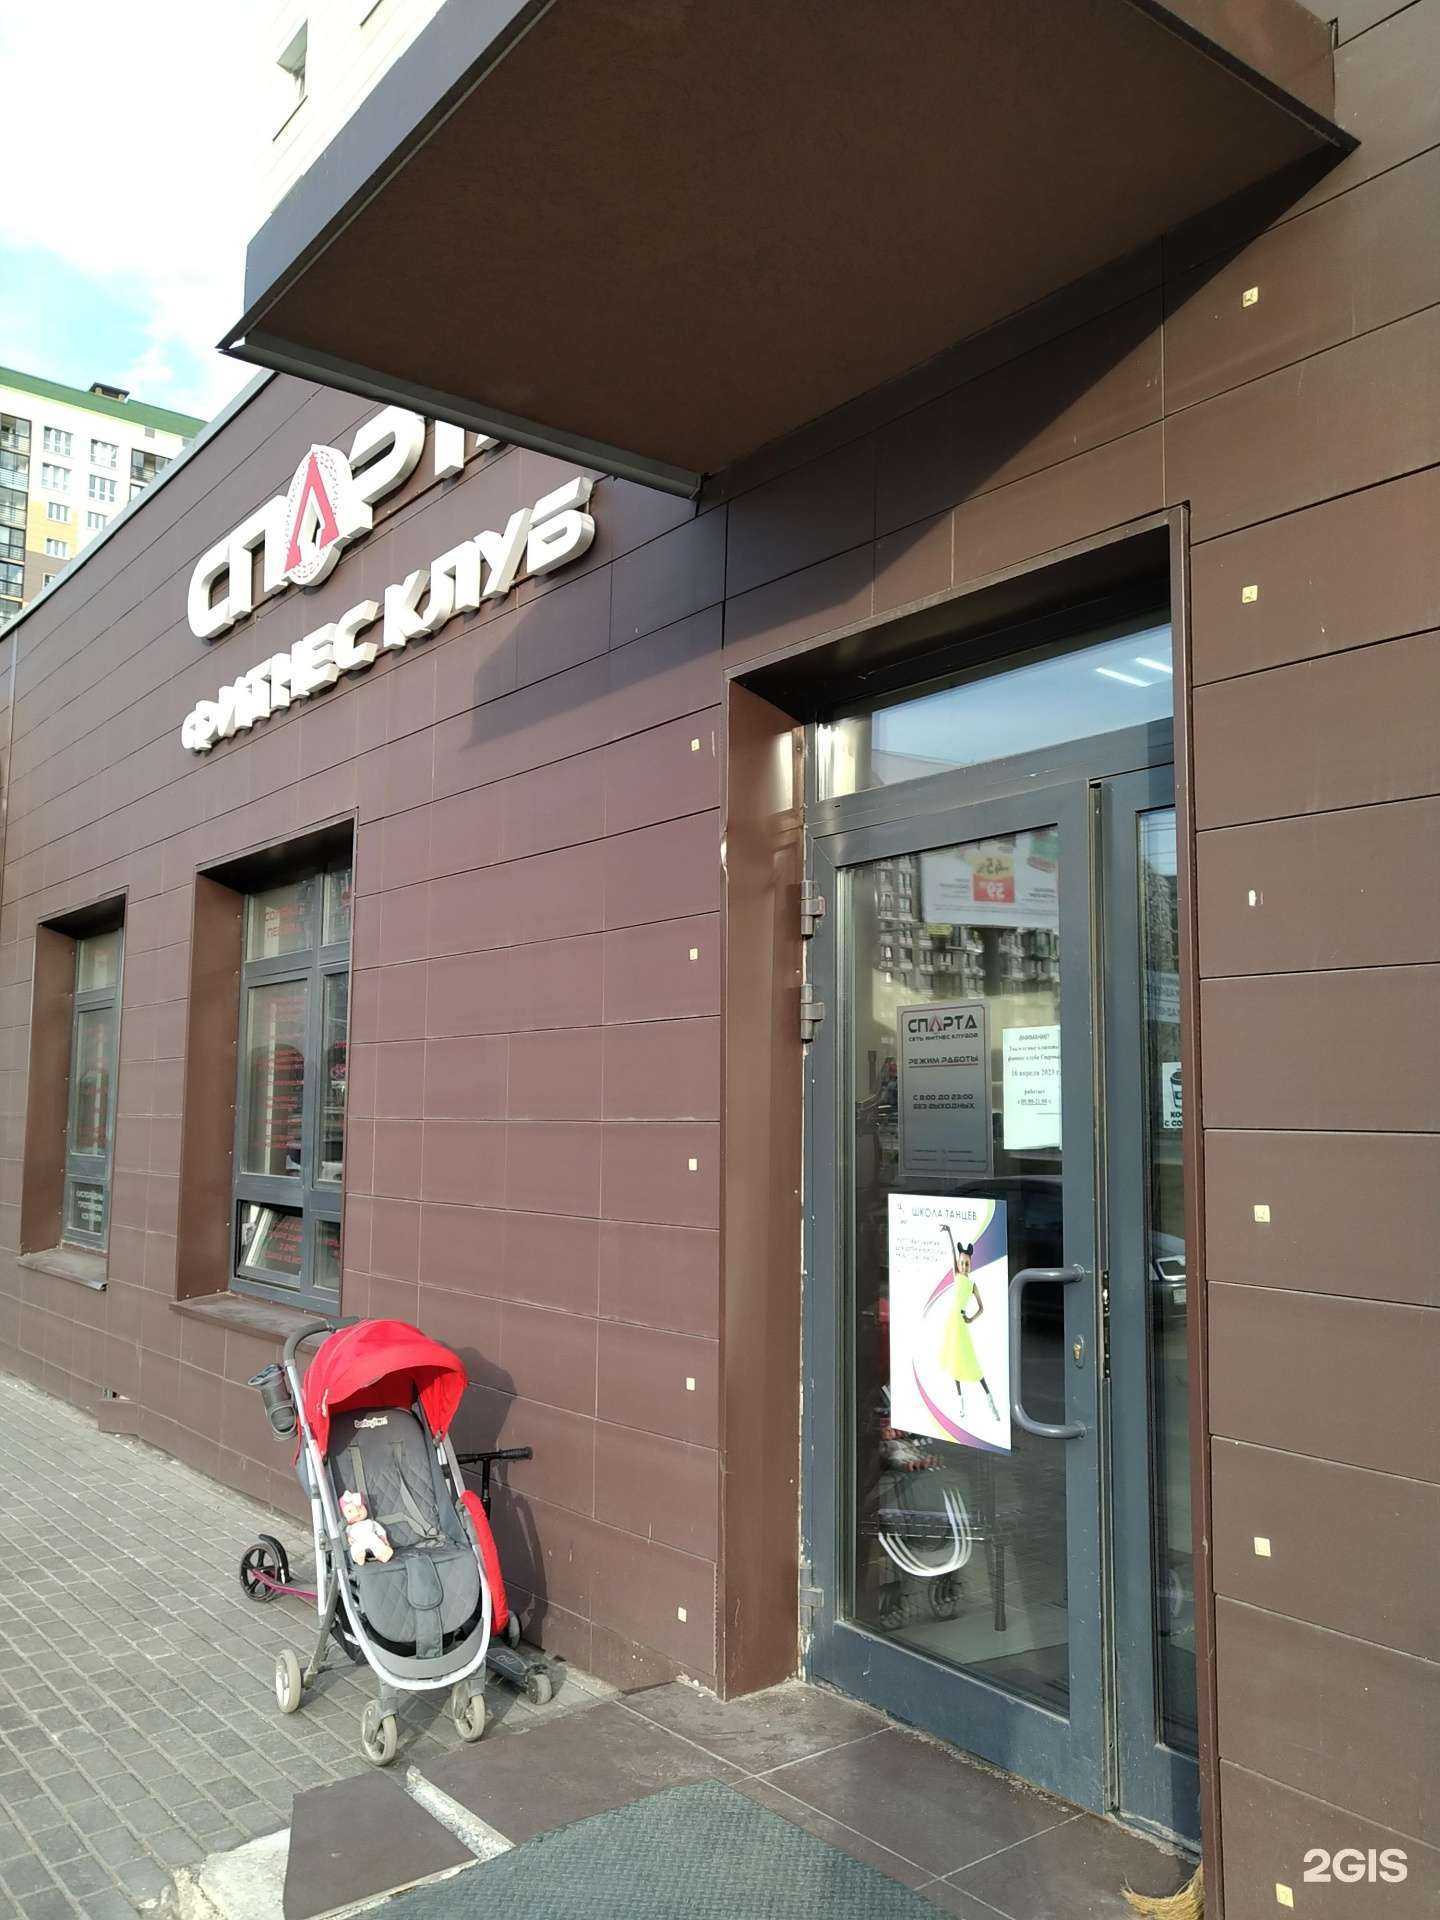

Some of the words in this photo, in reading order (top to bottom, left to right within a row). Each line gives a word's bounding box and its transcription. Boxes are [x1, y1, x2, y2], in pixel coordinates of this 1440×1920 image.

[188, 404, 502, 639] СПАР
[181, 599, 379, 751] ФИТНЕС
[383, 476, 596, 650] КЛУБ
[908, 1014, 978, 1033] СПАРТА
[908, 1057, 940, 1065] РЕЖИМ
[941, 1055, 979, 1064] РАБОТЫ
[911, 1207, 942, 1218] ШКОЛА
[944, 1208, 977, 1222] ТАНЦЕВ
